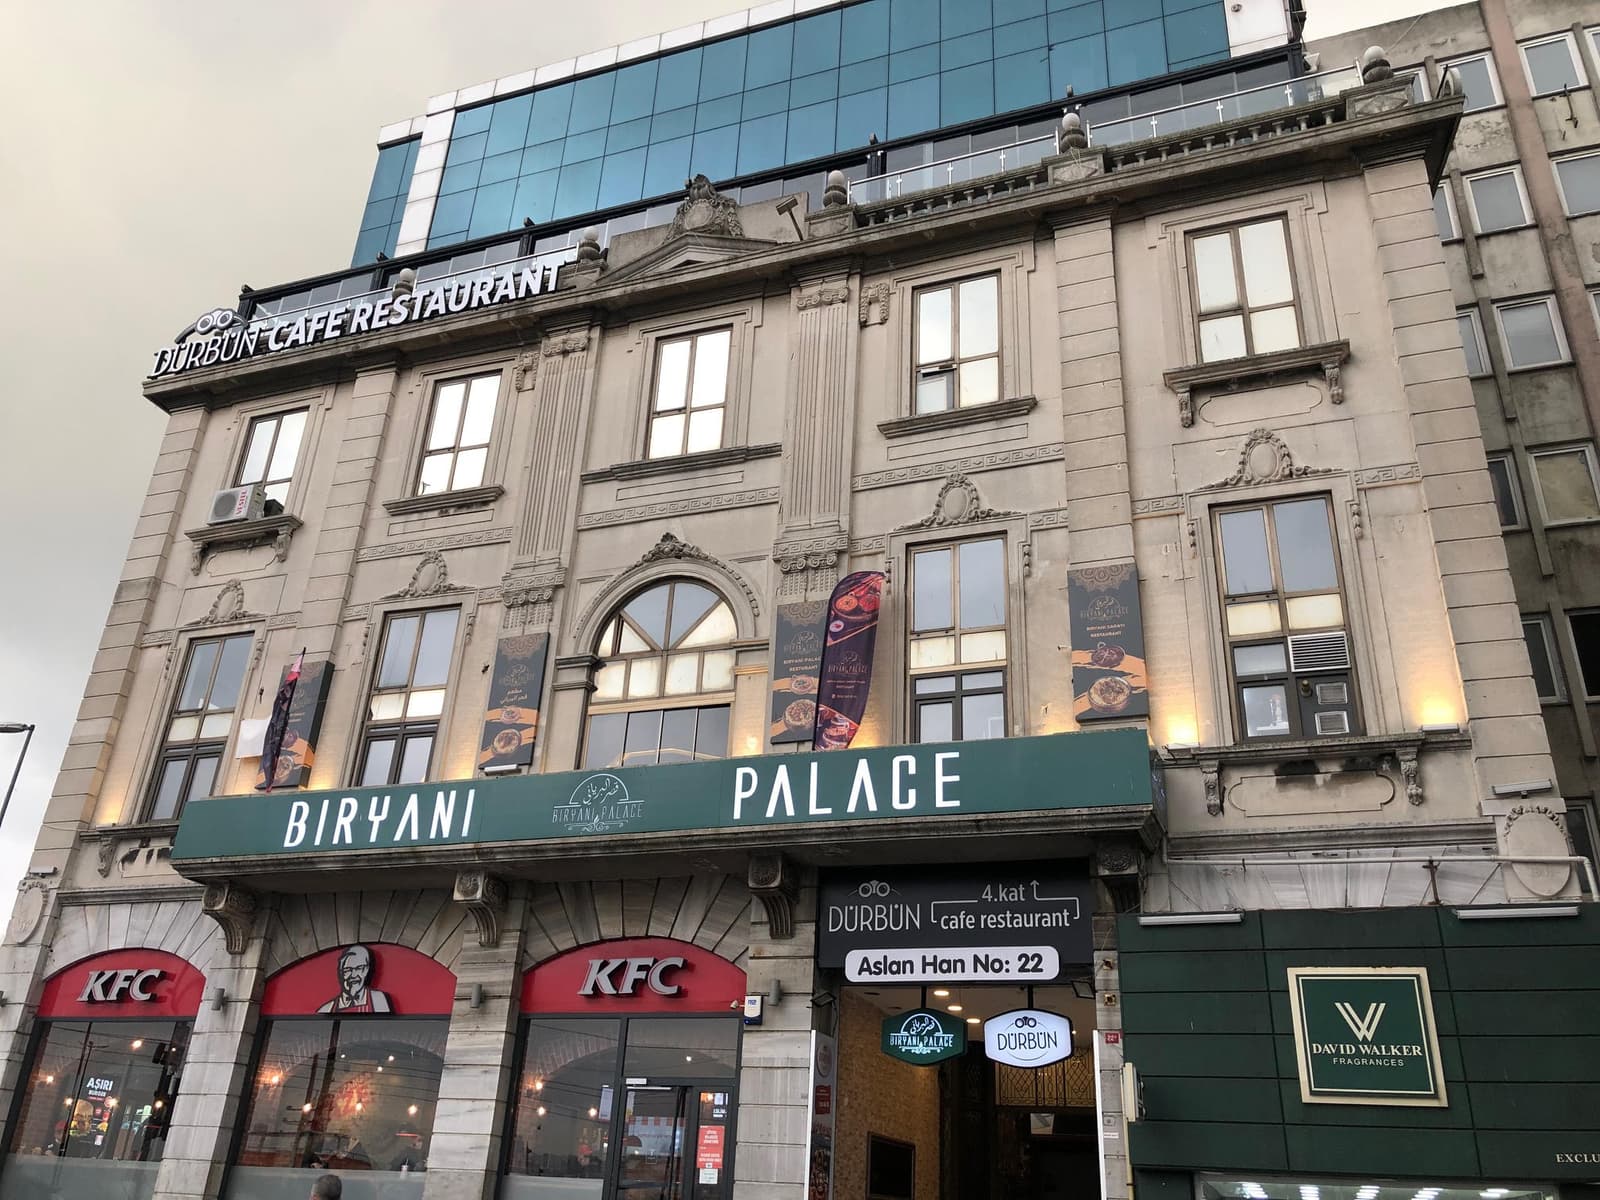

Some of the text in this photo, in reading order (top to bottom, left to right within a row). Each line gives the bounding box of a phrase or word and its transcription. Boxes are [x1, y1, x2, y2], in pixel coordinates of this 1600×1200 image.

[151, 261, 567, 378] DÜRBÜN CAFE RESTAURANT
[733, 751, 962, 820] PALACE
[283, 788, 477, 848] BIRYANI
[552, 803, 644, 823] BIRYANI PALACE
[982, 884, 1026, 902] 4.kat
[828, 903, 921, 933] DÜRBÜN
[940, 908, 1070, 929] cafe restaurant
[857, 952, 1044, 976] Aslan Han No: 22
[77, 968, 161, 1002] KFC
[578, 956, 686, 995] KFC
[889, 1034, 953, 1047] BIRYANI PALACE
[997, 1030, 1058, 1050] DÜRBÜN
[1312, 1043, 1423, 1056] DAVID WALKER
[1333, 1056, 1405, 1067] FRAGRANCES
